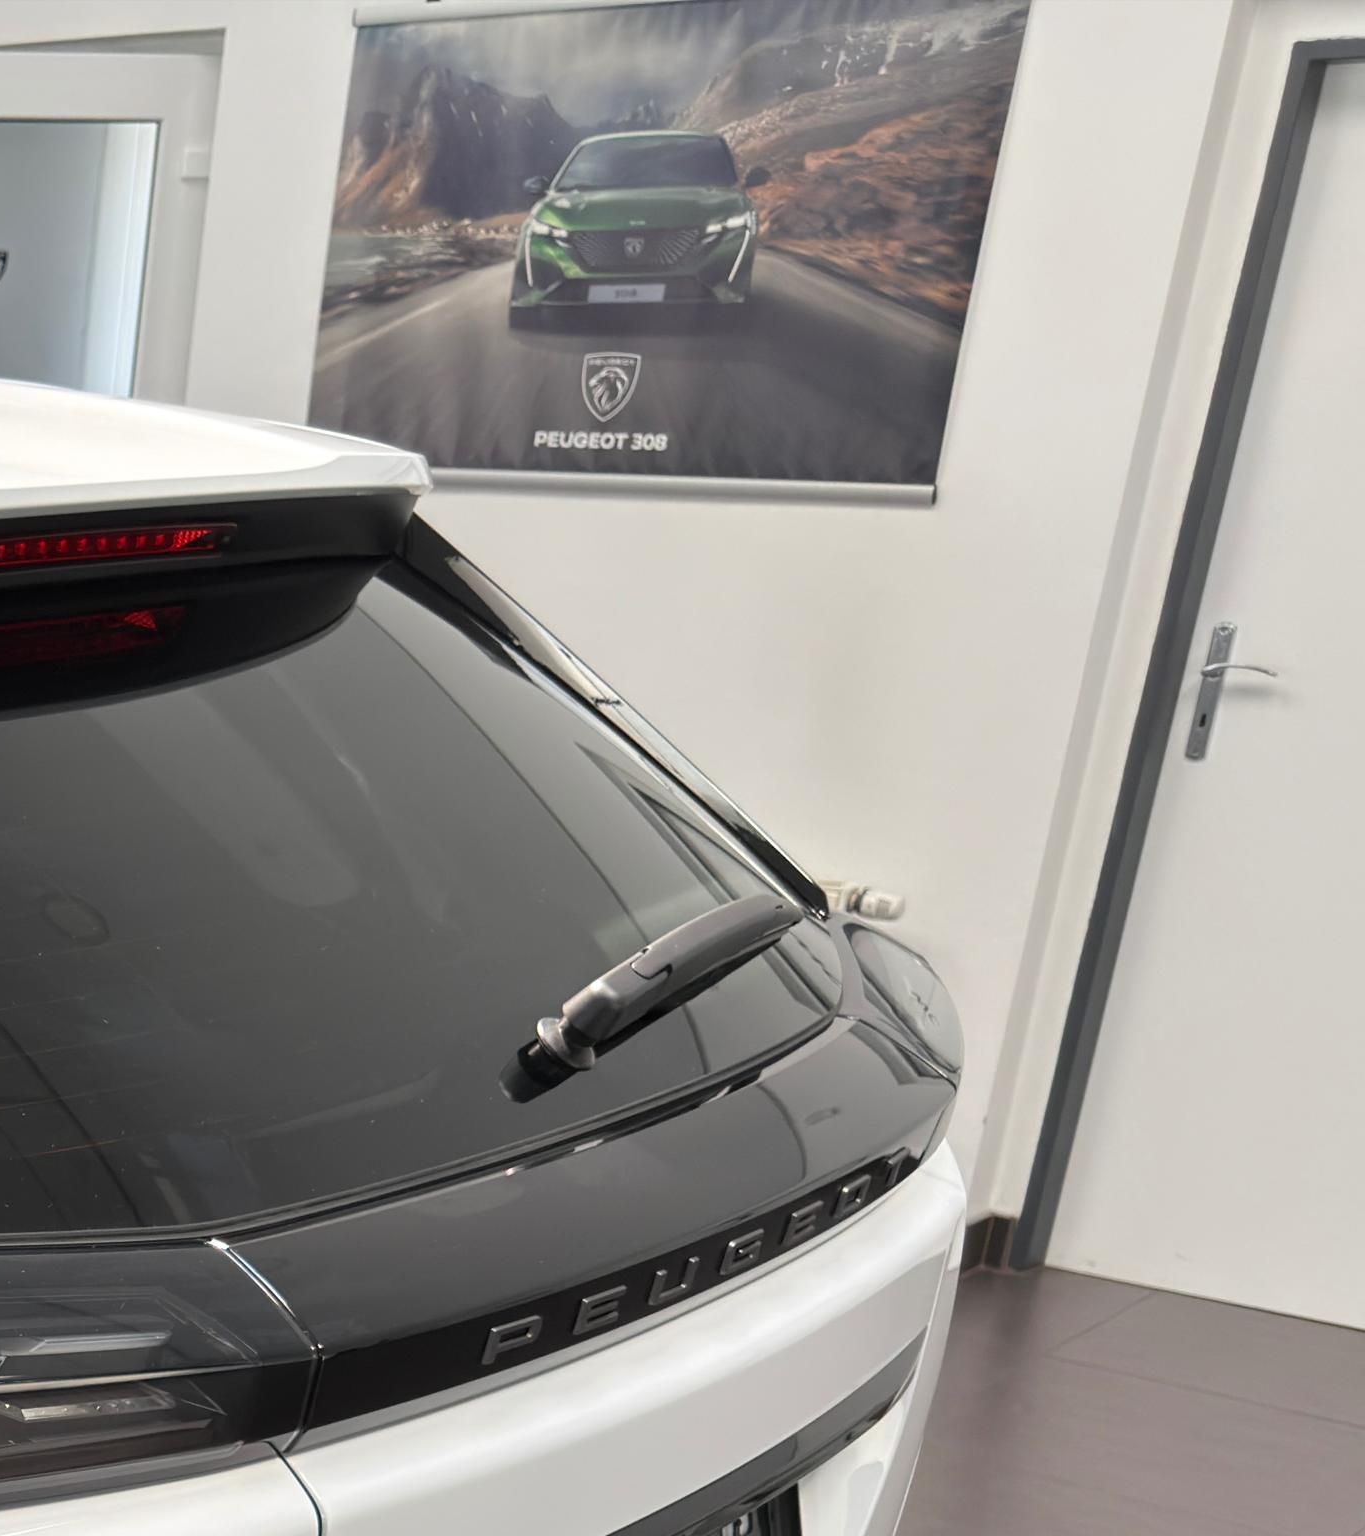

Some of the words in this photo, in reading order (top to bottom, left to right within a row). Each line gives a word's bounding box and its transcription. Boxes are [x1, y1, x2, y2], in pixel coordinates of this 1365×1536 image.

[533, 429, 630, 450] PEUGEOT
[630, 432, 669, 452] 308
[481, 1146, 911, 1366] PEUGEOT
